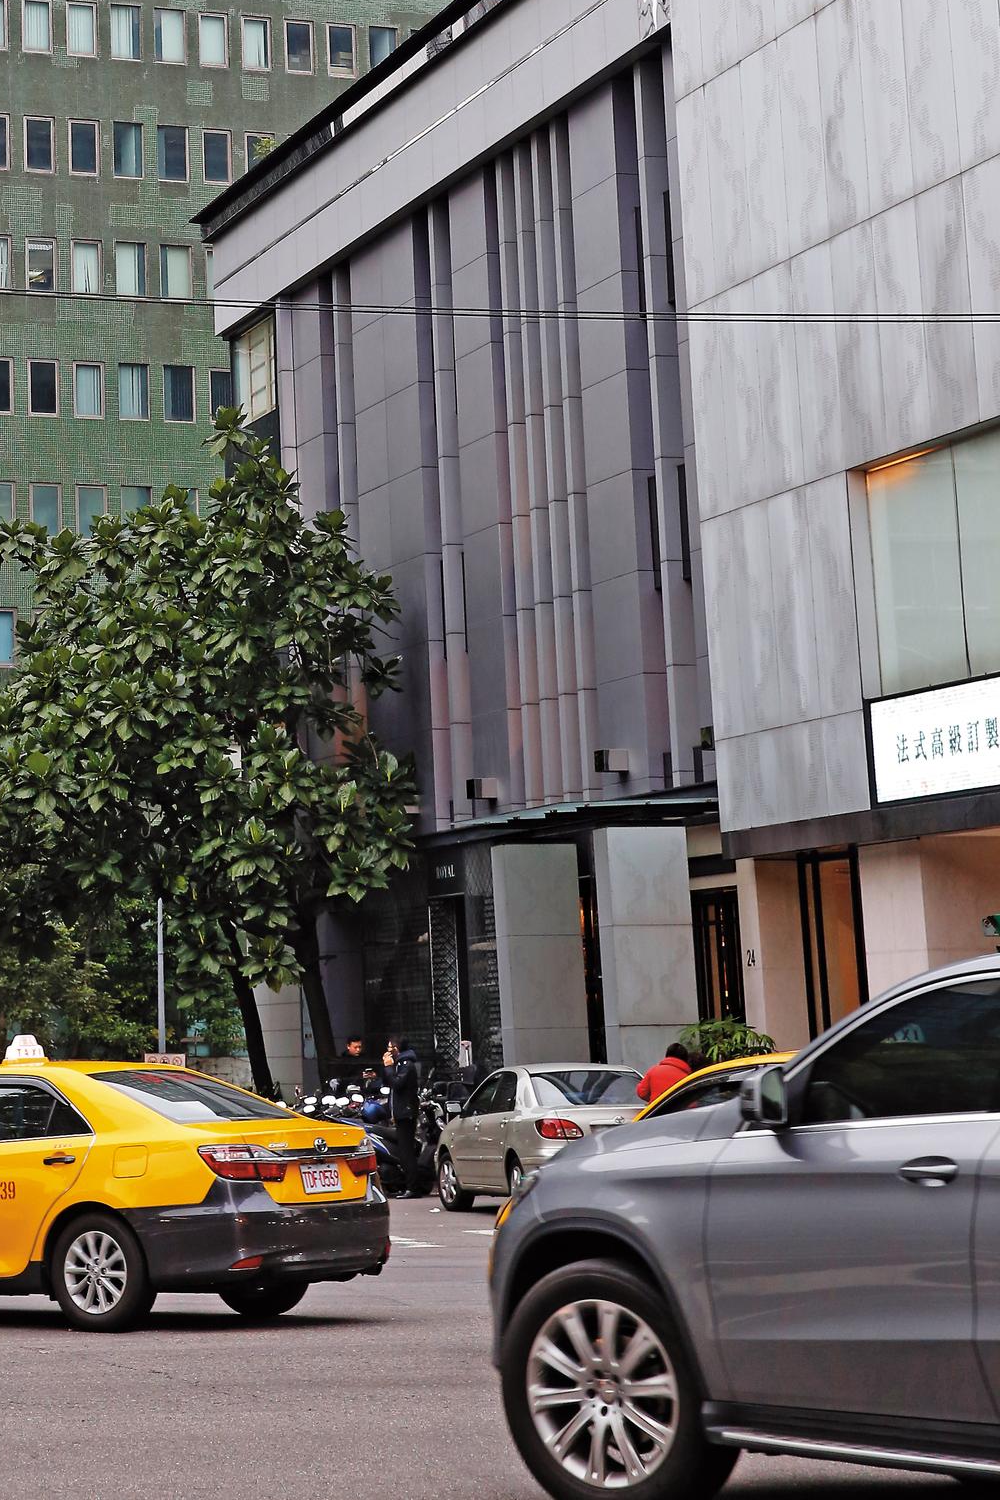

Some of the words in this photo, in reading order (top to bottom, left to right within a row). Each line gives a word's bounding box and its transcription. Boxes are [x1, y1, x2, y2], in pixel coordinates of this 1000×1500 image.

[896, 717, 1000, 764] 法式高級訂製
[746, 949, 756, 967] 24
